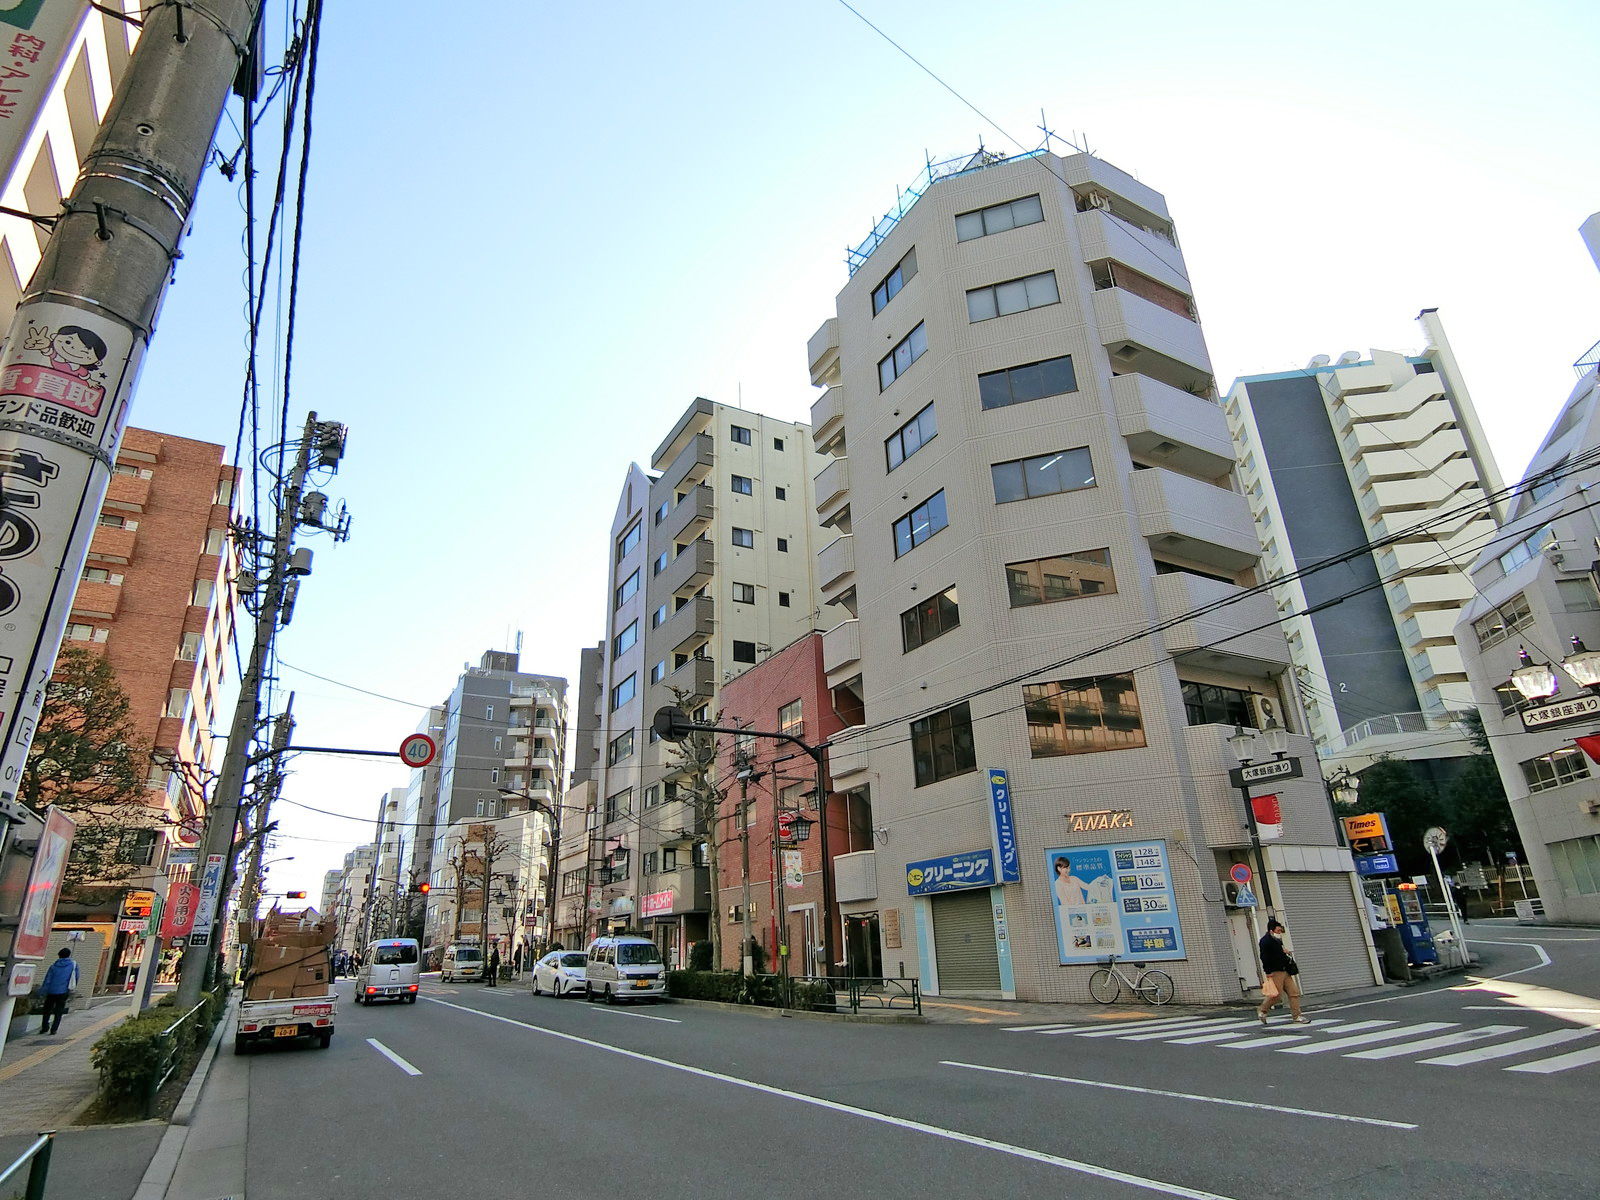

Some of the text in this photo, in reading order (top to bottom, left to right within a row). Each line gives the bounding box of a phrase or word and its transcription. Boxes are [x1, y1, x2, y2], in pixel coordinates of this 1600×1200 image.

[1340, 682, 1348, 692] 2
[1527, 699, 1598, 723] 大塚銀座通り
[408, 743, 428, 758] 40
[1244, 762, 1290, 779] 大塚銀座通り
[996, 789, 1014, 864] クリーニング
[1064, 809, 1134, 833] TANAKA
[1349, 819, 1376, 830] Times
[1138, 848, 1154, 856] 128
[924, 859, 989, 882] クリーニング
[201, 864, 219, 899] マルヨ
[1139, 877, 1154, 887] 10
[173, 886, 192, 926] 火の用心
[1142, 900, 1158, 910] 30
